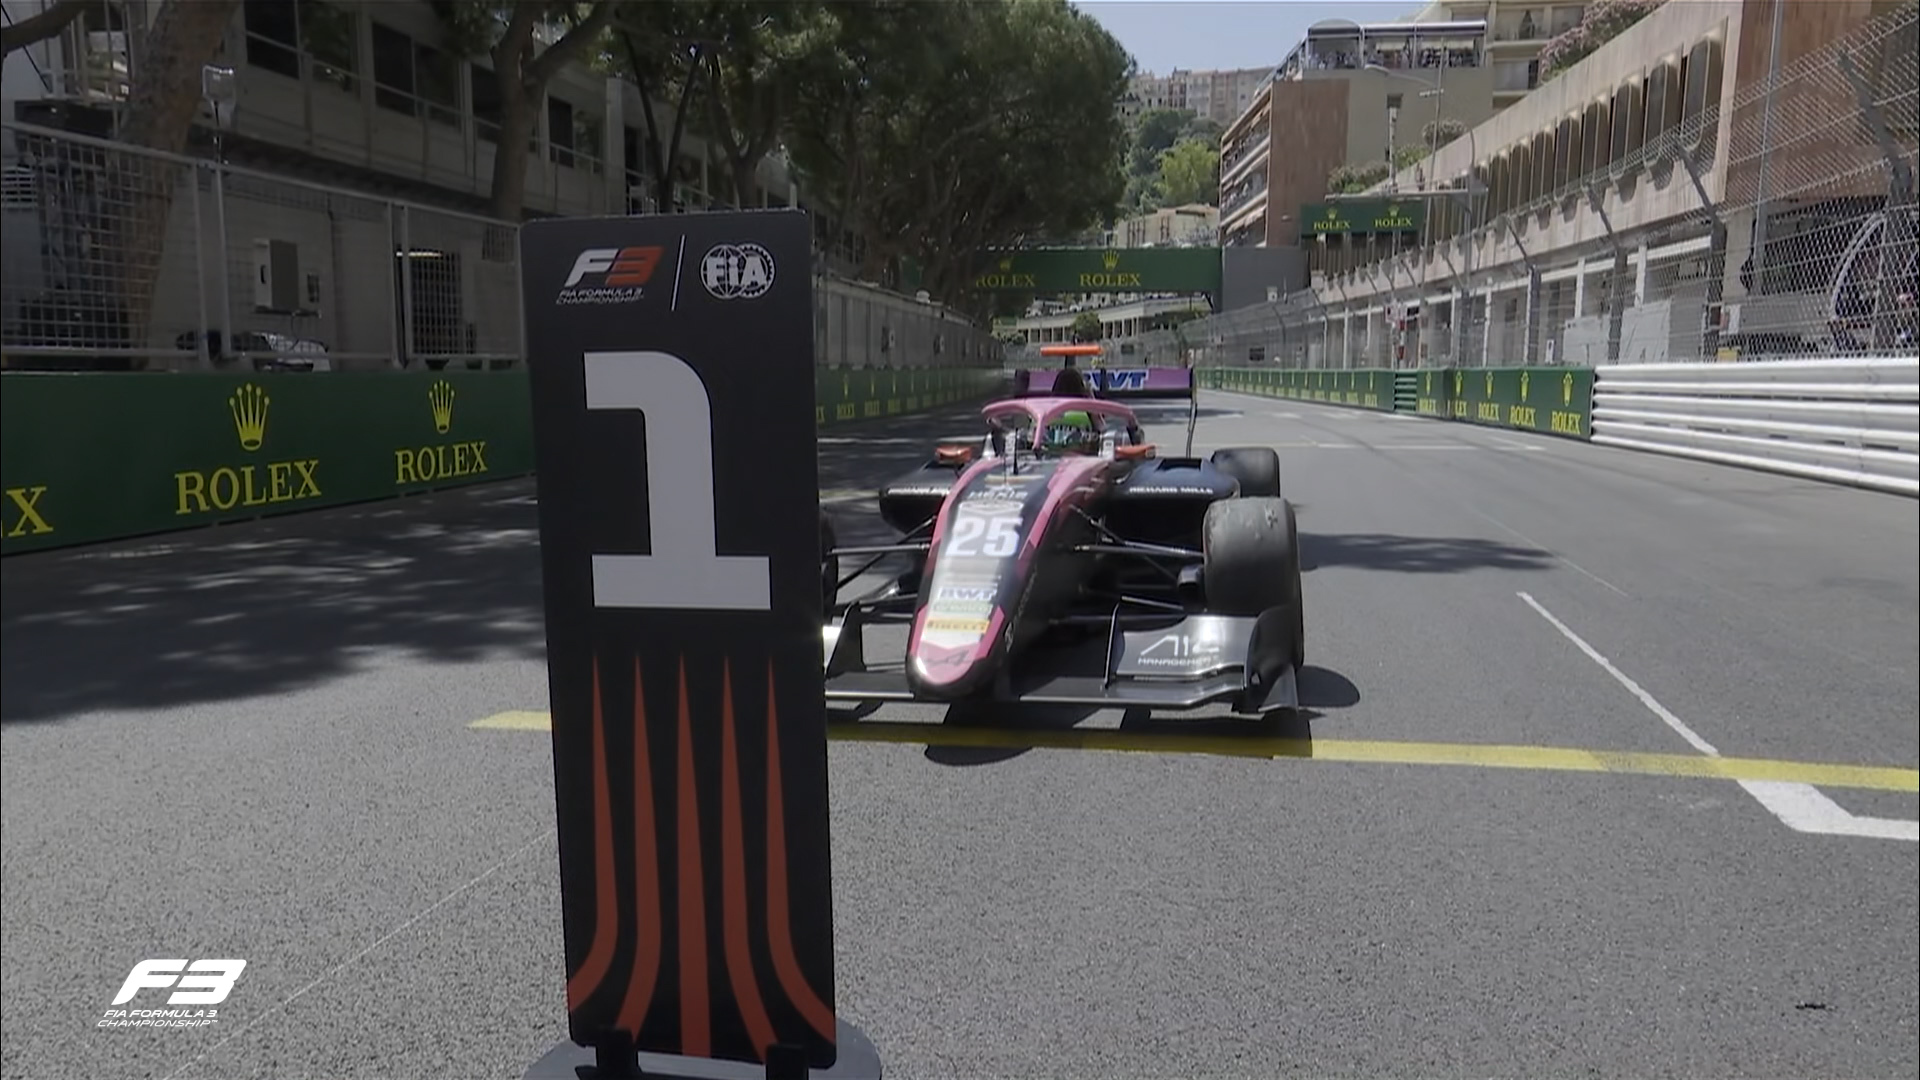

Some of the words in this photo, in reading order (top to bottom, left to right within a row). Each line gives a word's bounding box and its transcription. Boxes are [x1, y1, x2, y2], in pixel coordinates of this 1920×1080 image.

[1313, 219, 1351, 231] ROLEX
[1374, 216, 1412, 228] ROLEX
[564, 246, 664, 287] F3
[1079, 273, 1141, 287] ROLEX
[1478, 402, 1500, 421] ROLEX
[1509, 405, 1536, 428] ROLEX
[1550, 410, 1580, 435] ROLEX
[394, 441, 488, 484] ROLEX
[174, 459, 322, 515] ROLEX
[584, 351, 771, 610] 1
[945, 516, 1023, 558] 25
